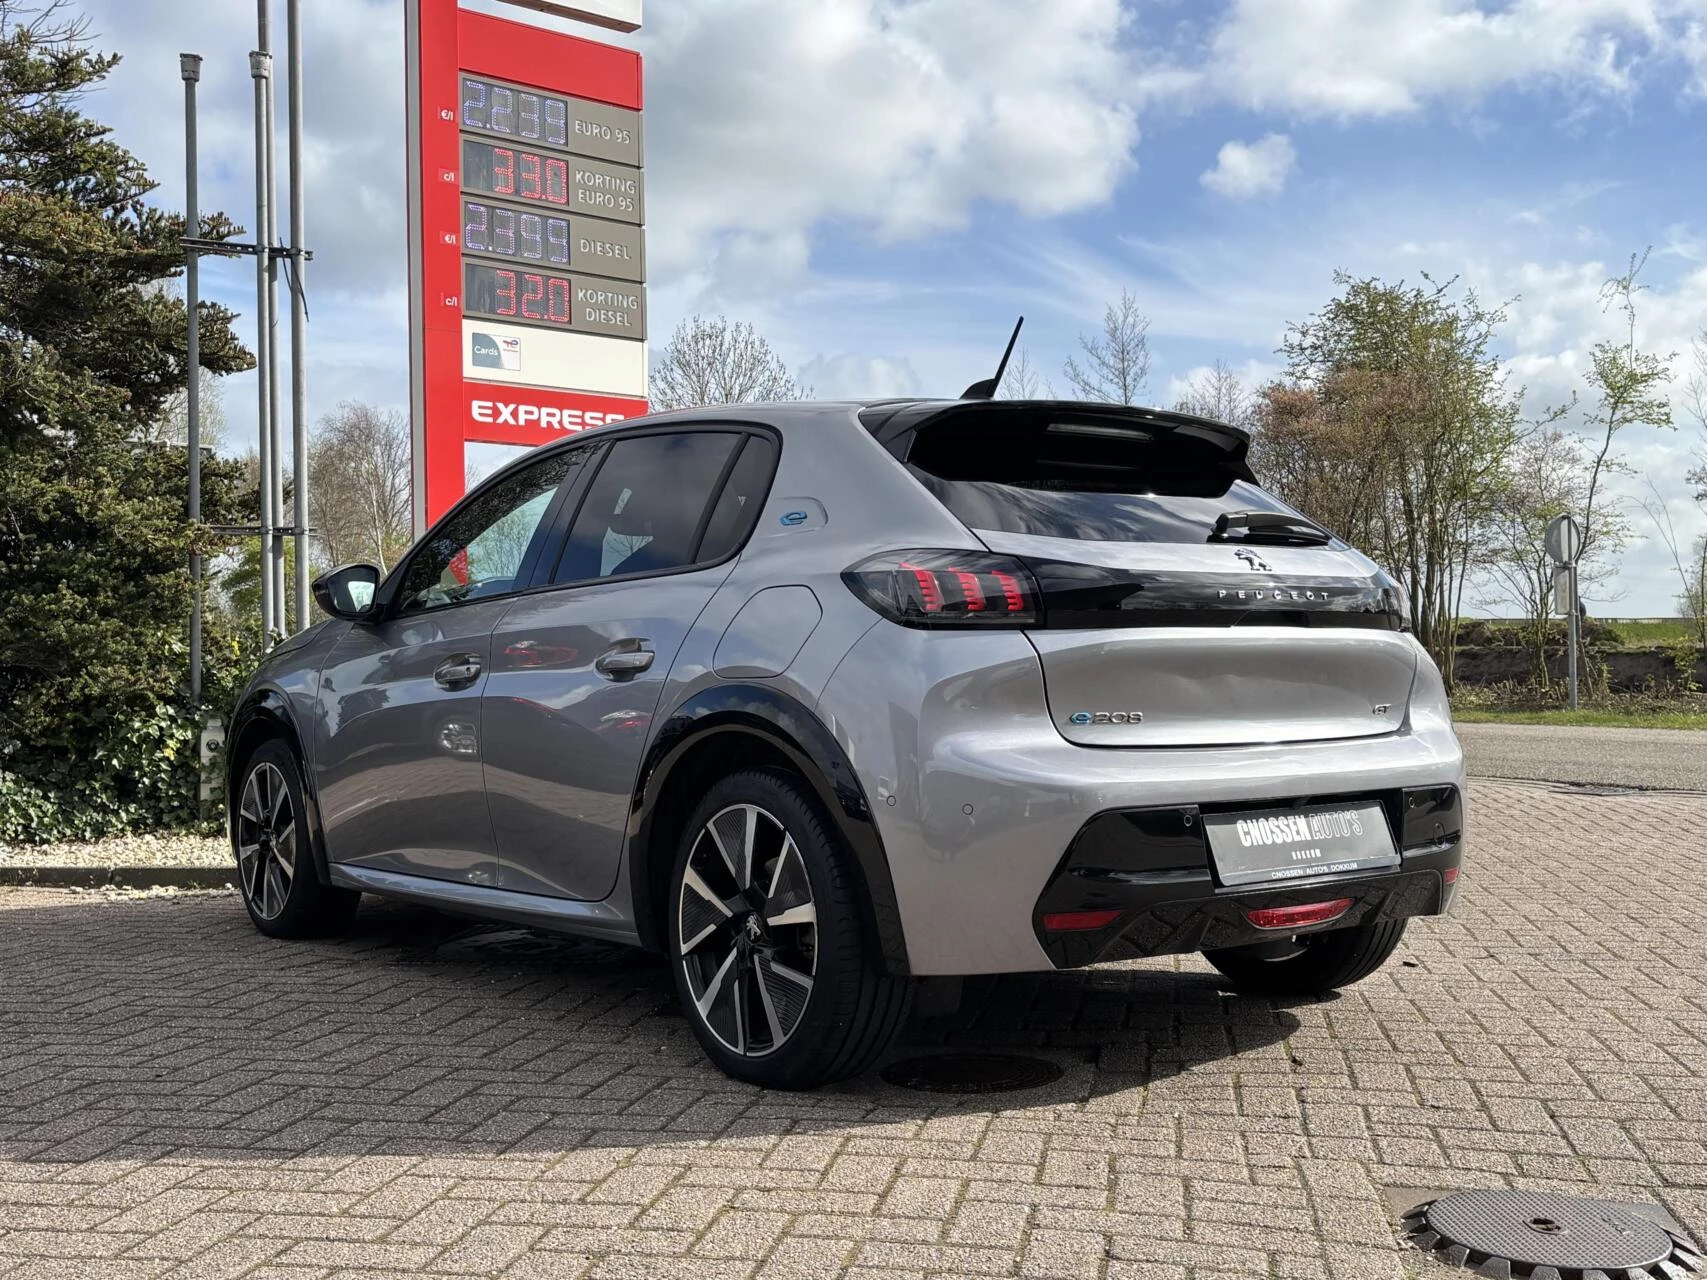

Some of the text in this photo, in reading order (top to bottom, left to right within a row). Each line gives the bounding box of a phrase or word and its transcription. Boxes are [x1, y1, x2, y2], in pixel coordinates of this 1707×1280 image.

[441, 109, 453, 121] €/l
[464, 80, 567, 144] 2.239
[575, 120, 631, 144] EURO 95
[443, 171, 455, 182] c/l
[494, 148, 567, 204] 33.0
[576, 170, 636, 194] KORTING
[578, 189, 634, 211] EURO 95
[445, 234, 456, 244] €/l
[465, 204, 568, 263] 2.399
[580, 239, 632, 260] DIESEL
[446, 296, 458, 307] c/l
[496, 270, 569, 322] 32.0
[578, 288, 639, 310] KORTING
[586, 308, 632, 327] DIESEL
[474, 345, 499, 356] Cards
[1217, 589, 1329, 601] PEUGEOT
[1373, 703, 1392, 715] GT
[1236, 810, 1363, 847] CNOSSEN AUTO'S
[1271, 862, 1358, 879] CNOSSEN AUTO'S DOKKUM
